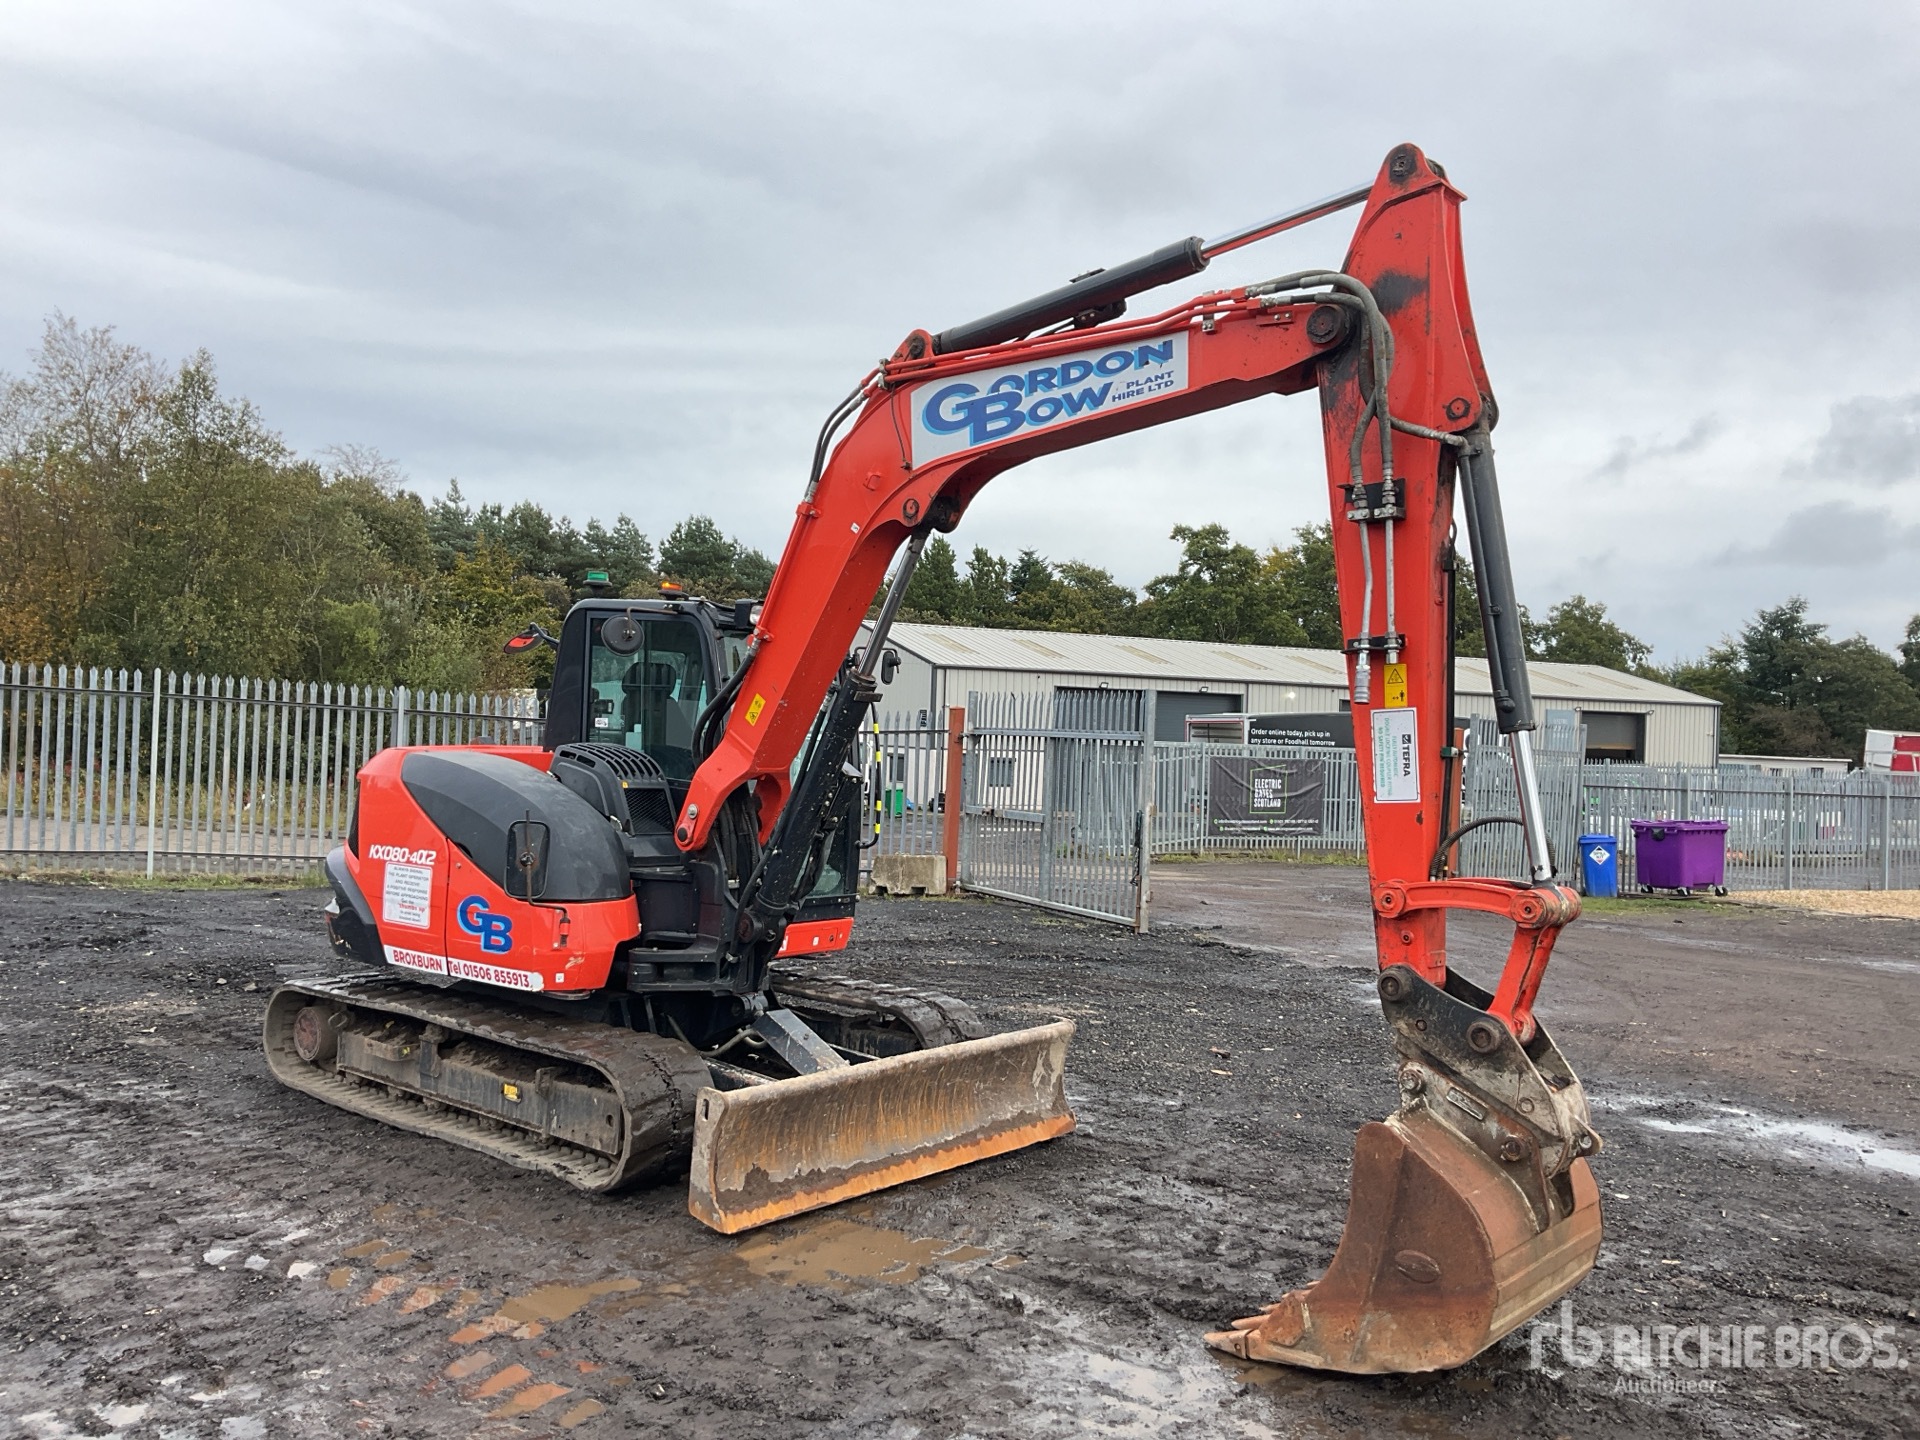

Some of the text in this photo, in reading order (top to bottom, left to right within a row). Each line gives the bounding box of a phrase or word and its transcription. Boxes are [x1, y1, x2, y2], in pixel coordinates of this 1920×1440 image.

[922, 340, 1173, 435] GORDON
[1126, 370, 1174, 389] PLANT
[1111, 380, 1174, 402] HIRE LTD
[970, 381, 1113, 446] BOW
[1285, 738, 1309, 746] Foodhall
[1287, 730, 1304, 738] today,
[1304, 730, 1316, 738] pick
[1402, 745, 1411, 777] TEFRA
[1254, 778, 1282, 789] ELECTRIC
[1254, 788, 1273, 799] GATES
[1253, 798, 1281, 808] SCOTLAND
[457, 894, 513, 955] GB
[393, 949, 443, 972] BROXBURN
[448, 960, 530, 989] Tel 01506 855913
